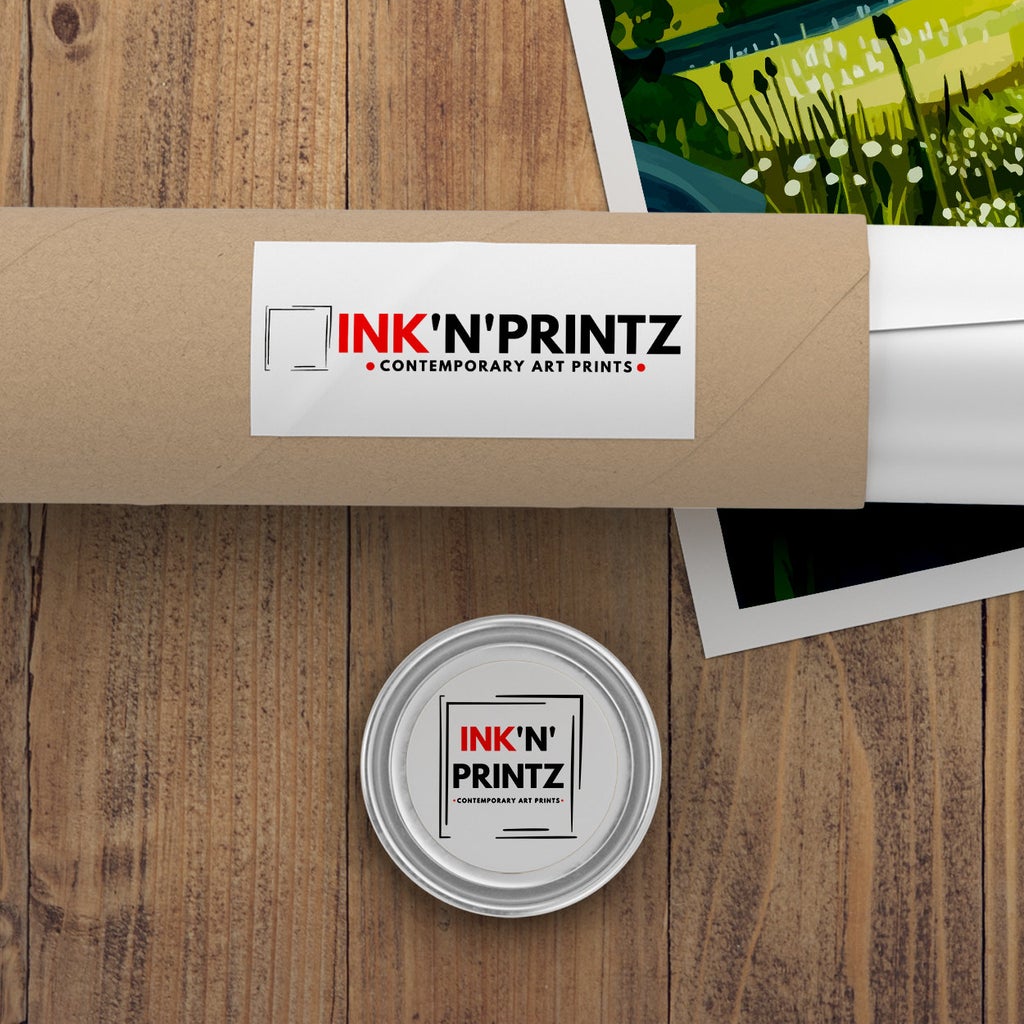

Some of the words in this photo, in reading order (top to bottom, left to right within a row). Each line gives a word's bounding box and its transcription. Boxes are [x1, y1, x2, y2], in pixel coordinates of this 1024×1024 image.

[338, 312, 683, 355] INK'N'PRINTZ
[379, 359, 525, 373] CONTEMPORARY
[531, 360, 565, 373] ART
[572, 360, 633, 374] PRINTS
[460, 725, 556, 752] INK'N'
[452, 763, 565, 789] PRINTZ
